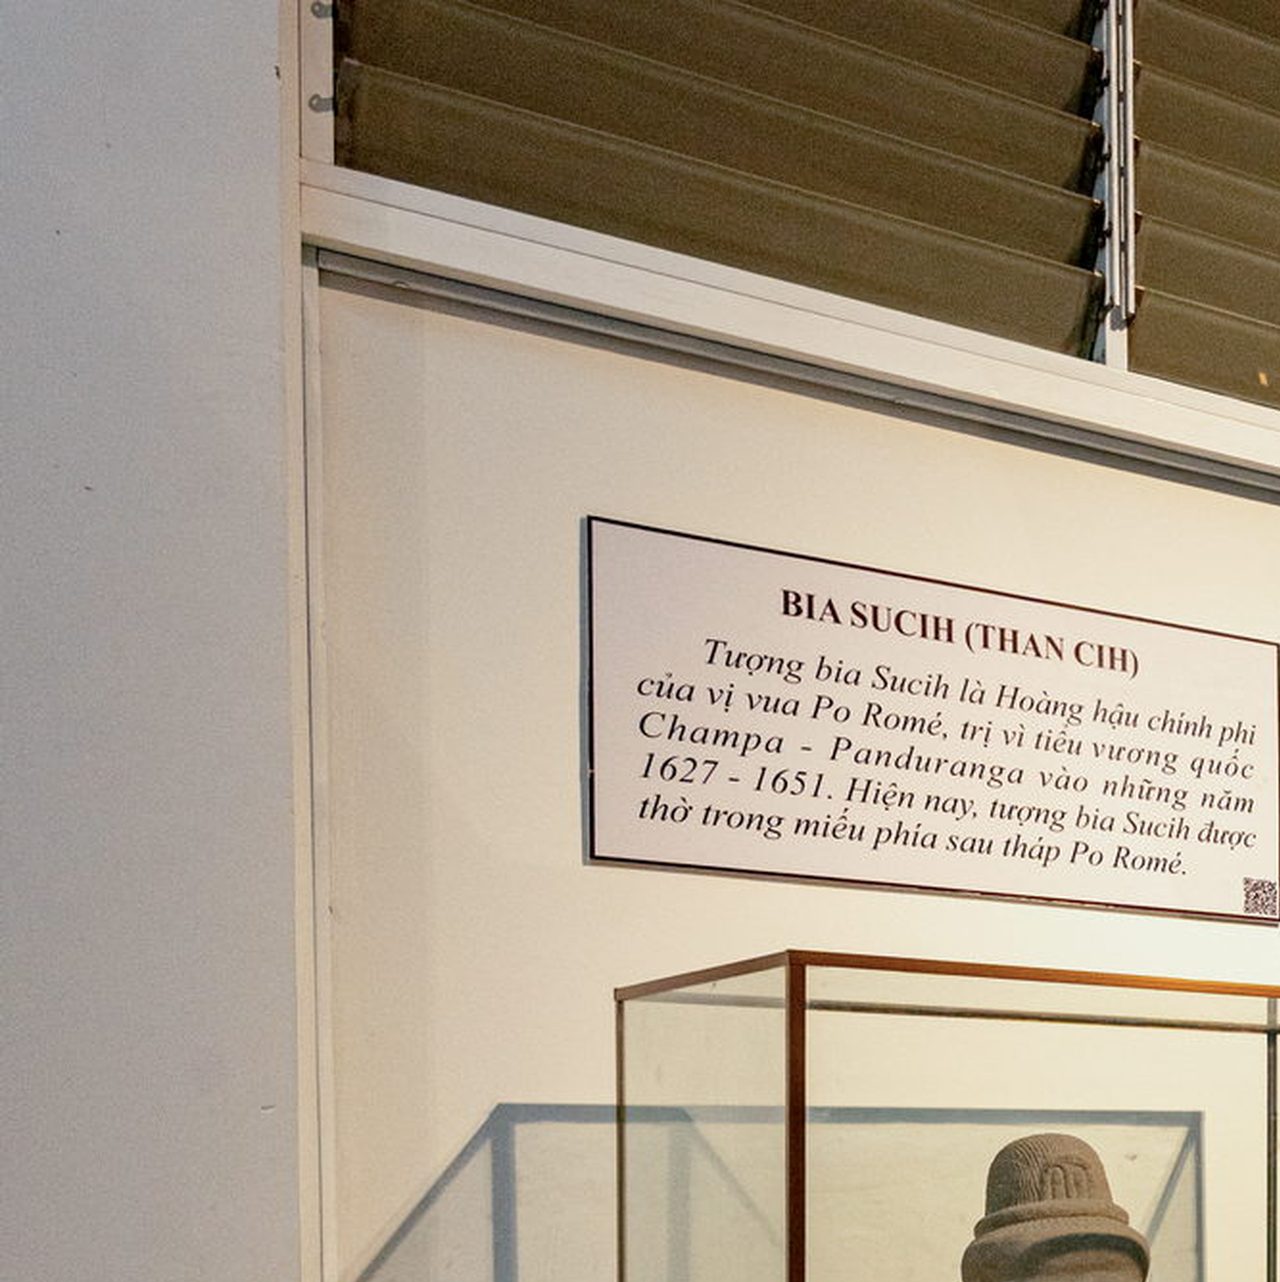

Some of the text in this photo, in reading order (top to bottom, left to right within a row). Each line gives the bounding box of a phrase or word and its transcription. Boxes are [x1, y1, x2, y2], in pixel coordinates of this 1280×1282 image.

[781, 589, 1139, 678] BIA SUCIH (THAN CIH)
[637, 673, 1254, 779] của vị vua Po Romé, trị vì tiểu vương quốc
[705, 638, 1256, 747] Tượng bia Sucih là Hoàng hậu chính phi
[639, 712, 784, 757] Champa
[830, 736, 1024, 789] Panduranga
[1040, 766, 1088, 792] vào
[1103, 774, 1188, 811] những
[1201, 790, 1254, 813] năm
[641, 753, 719, 784] 1627
[754, 766, 832, 799] 1651.
[845, 777, 914, 811] Hiện
[924, 795, 977, 821] nay,
[990, 799, 1067, 833] tượng
[1075, 804, 1115, 832] bia
[1123, 811, 1190, 840] Sucih
[1197, 820, 1256, 850] được
[639, 794, 1186, 875] thờ trong miếu phía sau tháp Po Romé.
